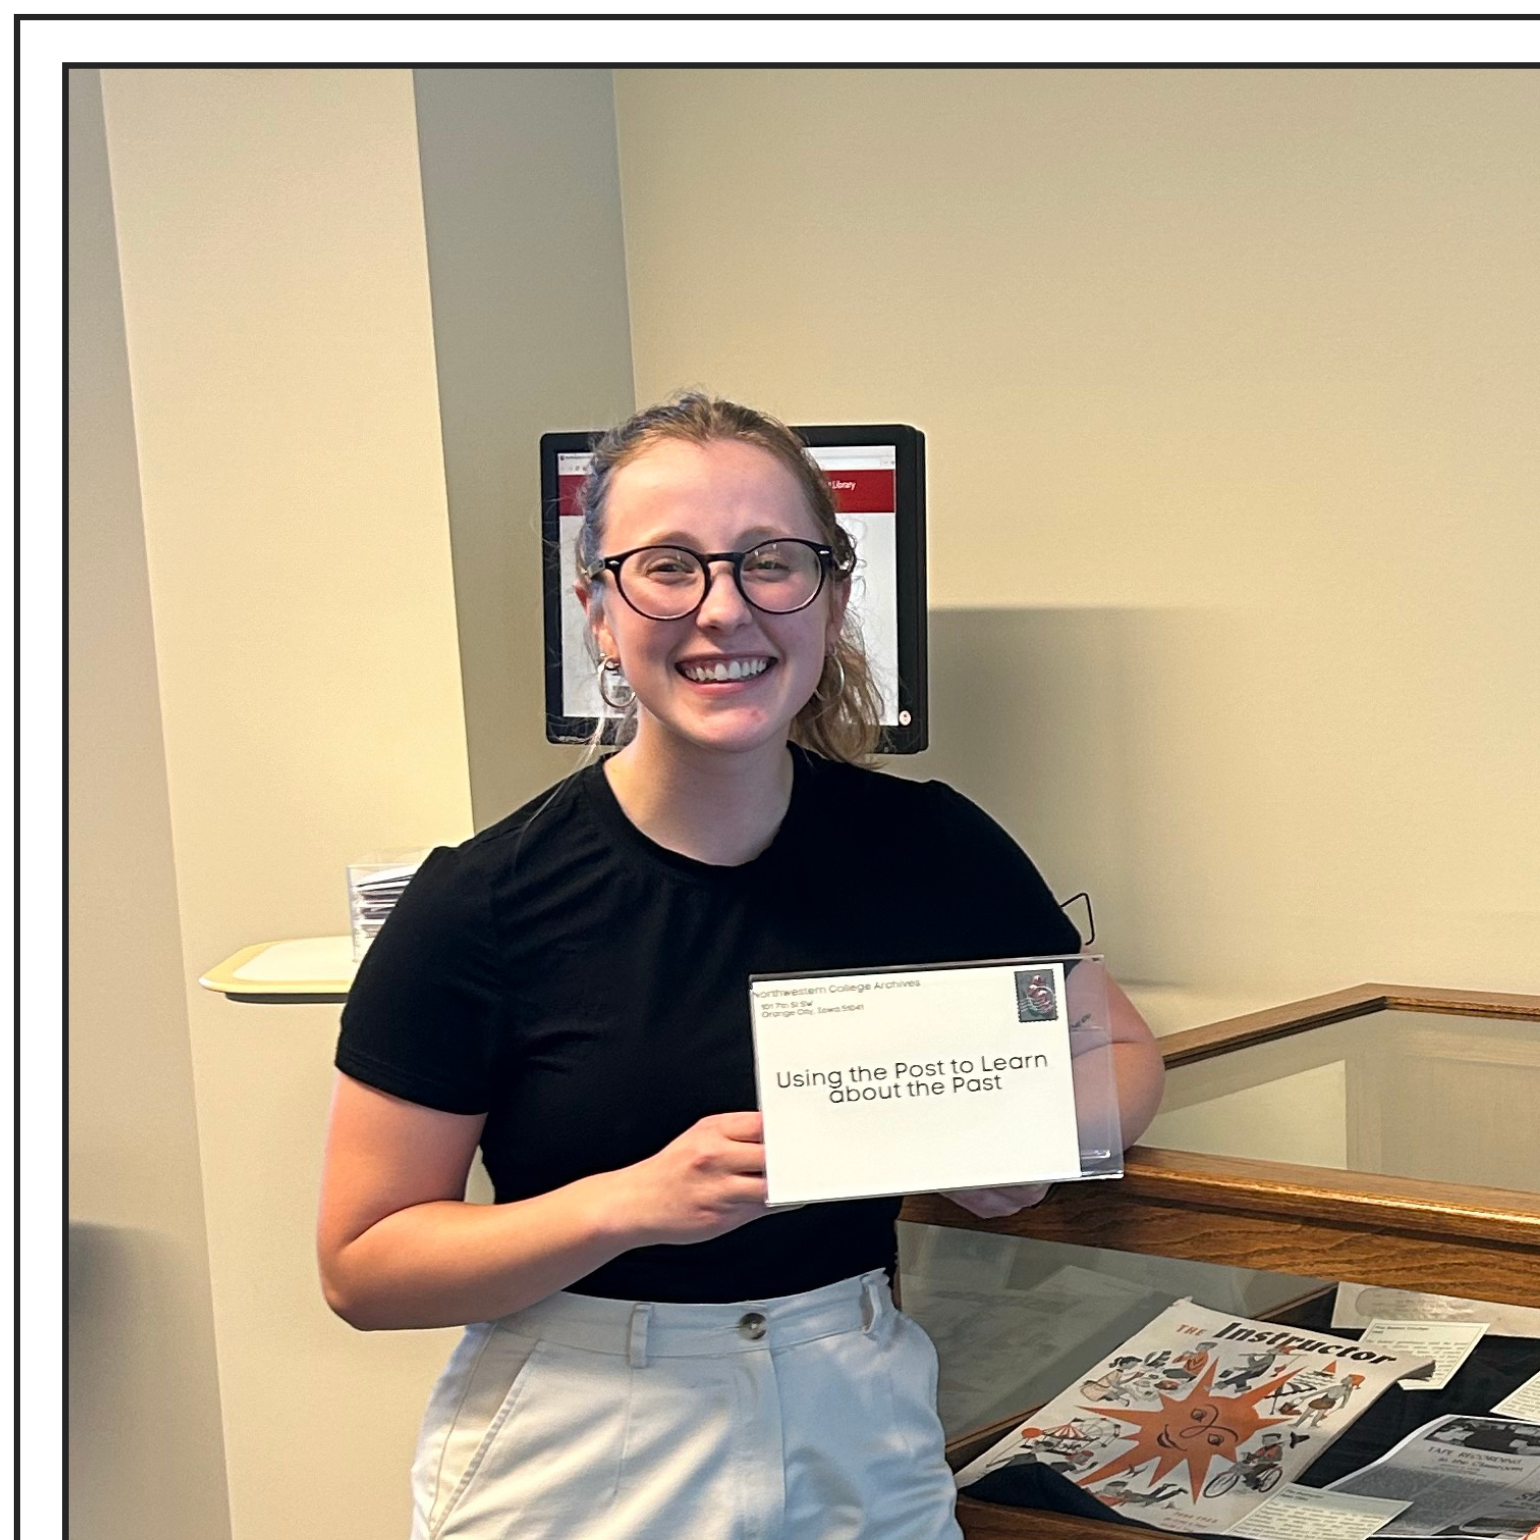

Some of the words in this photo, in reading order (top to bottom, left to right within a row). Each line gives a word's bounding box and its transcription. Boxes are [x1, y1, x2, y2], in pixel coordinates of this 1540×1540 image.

[829, 983, 871, 993] College
[874, 980, 921, 990] Archives
[761, 1010, 795, 1018] Orange
[776, 1069, 843, 1090] Using
[849, 1064, 887, 1082] the
[895, 1060, 945, 1079] Post
[951, 1058, 974, 1075] to
[981, 1052, 1048, 1073] Learn
[829, 1079, 902, 1104] about
[907, 1077, 945, 1097] the
[953, 1074, 1002, 1094] Past
[1176, 1324, 1208, 1337] THE
[1212, 1322, 1398, 1365] Instructor
